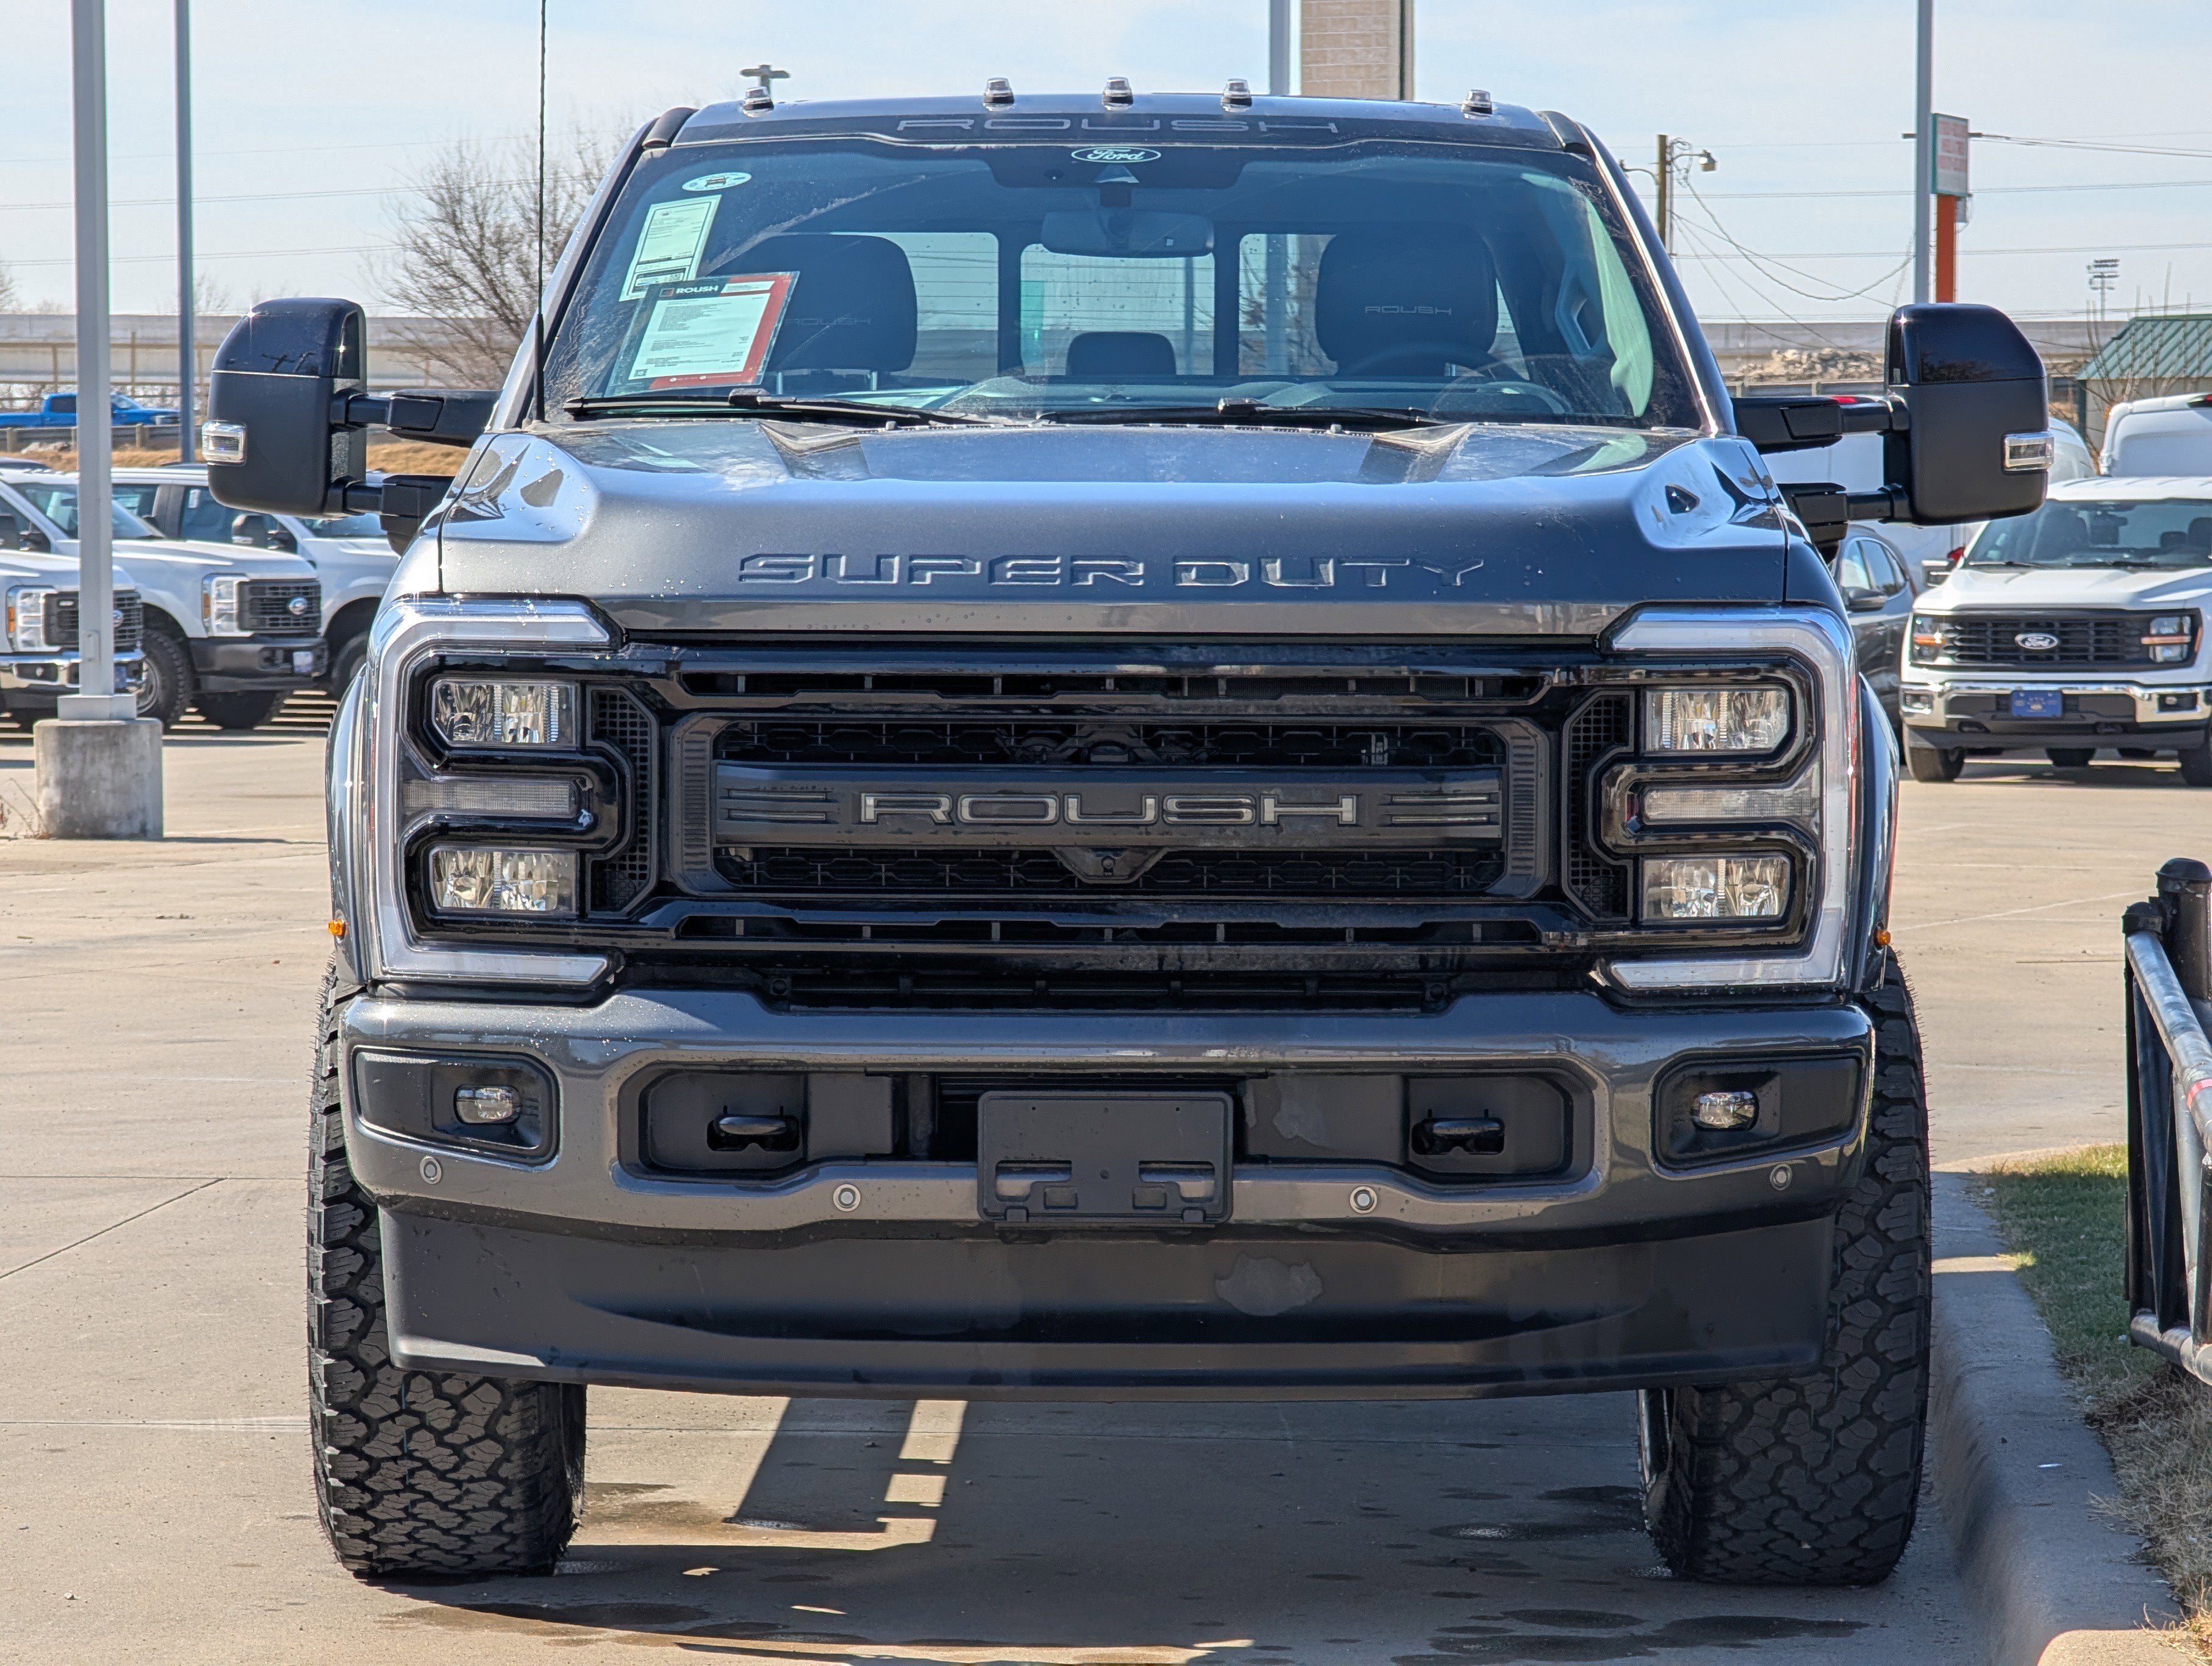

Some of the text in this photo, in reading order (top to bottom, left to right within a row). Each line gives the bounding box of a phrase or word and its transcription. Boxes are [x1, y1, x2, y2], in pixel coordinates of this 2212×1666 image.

[897, 118, 1338, 133] ROUSH
[1086, 149, 1145, 159] Ford
[676, 285, 719, 294] ROUSH
[1365, 305, 1451, 315] ROUSH
[739, 553, 1484, 586] SUPER DUTY
[860, 793, 1356, 825] ROUSH
